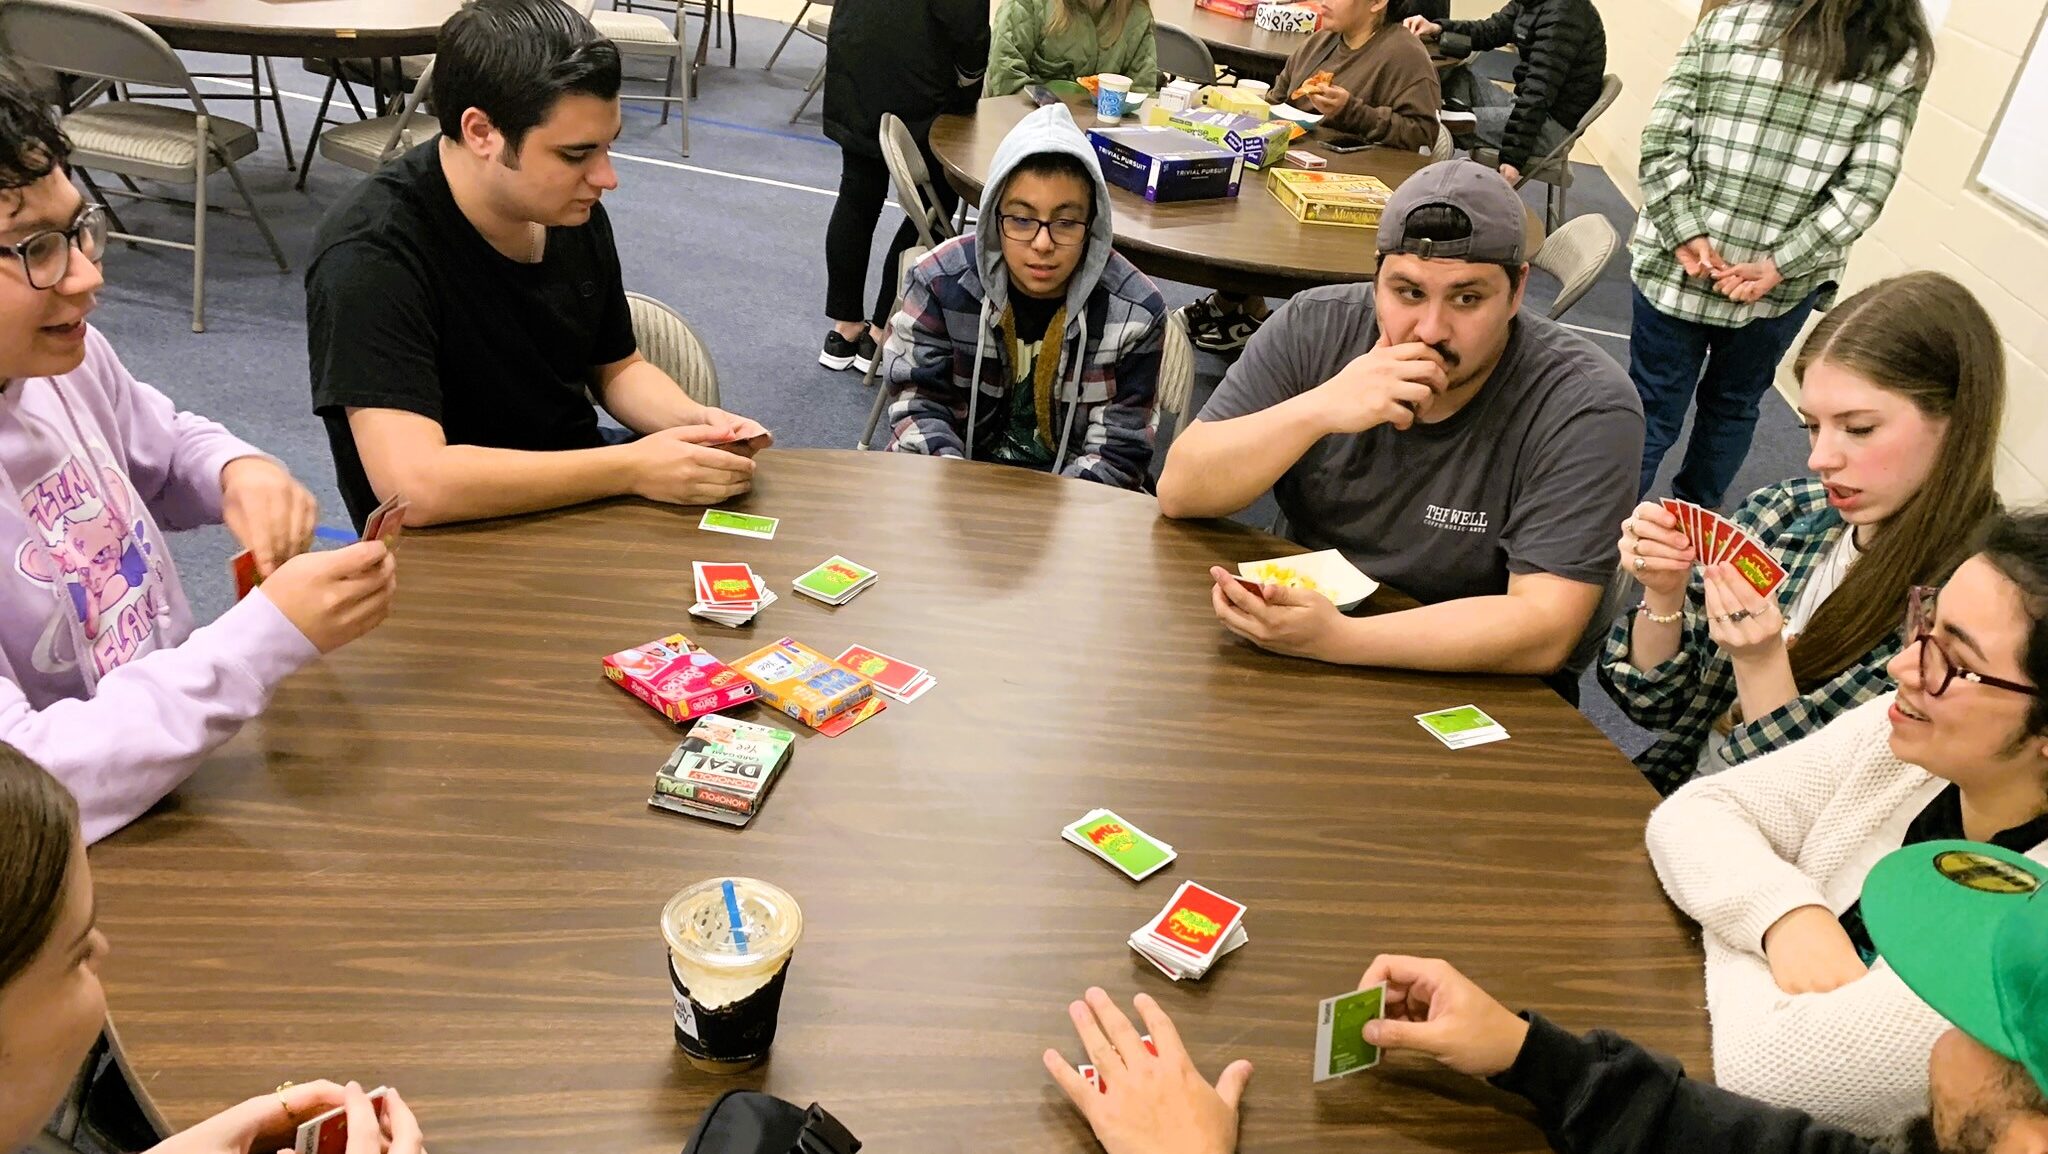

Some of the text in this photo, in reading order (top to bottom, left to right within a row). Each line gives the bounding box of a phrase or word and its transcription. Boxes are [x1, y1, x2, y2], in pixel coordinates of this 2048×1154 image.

[1098, 145, 1147, 171] TRIVIAL PURSUIT
[1176, 167, 1228, 176] TRIVIAL PURSUIT
[1450, 509, 1488, 527] WELL
[661, 665, 706, 692] Barbie
[692, 694, 718, 711] Barbie
[692, 753, 763, 779] DEAL
[660, 779, 695, 798] DEAL
[692, 772, 756, 789] MONOPOLY
[699, 792, 748, 811] MONOPOLY
